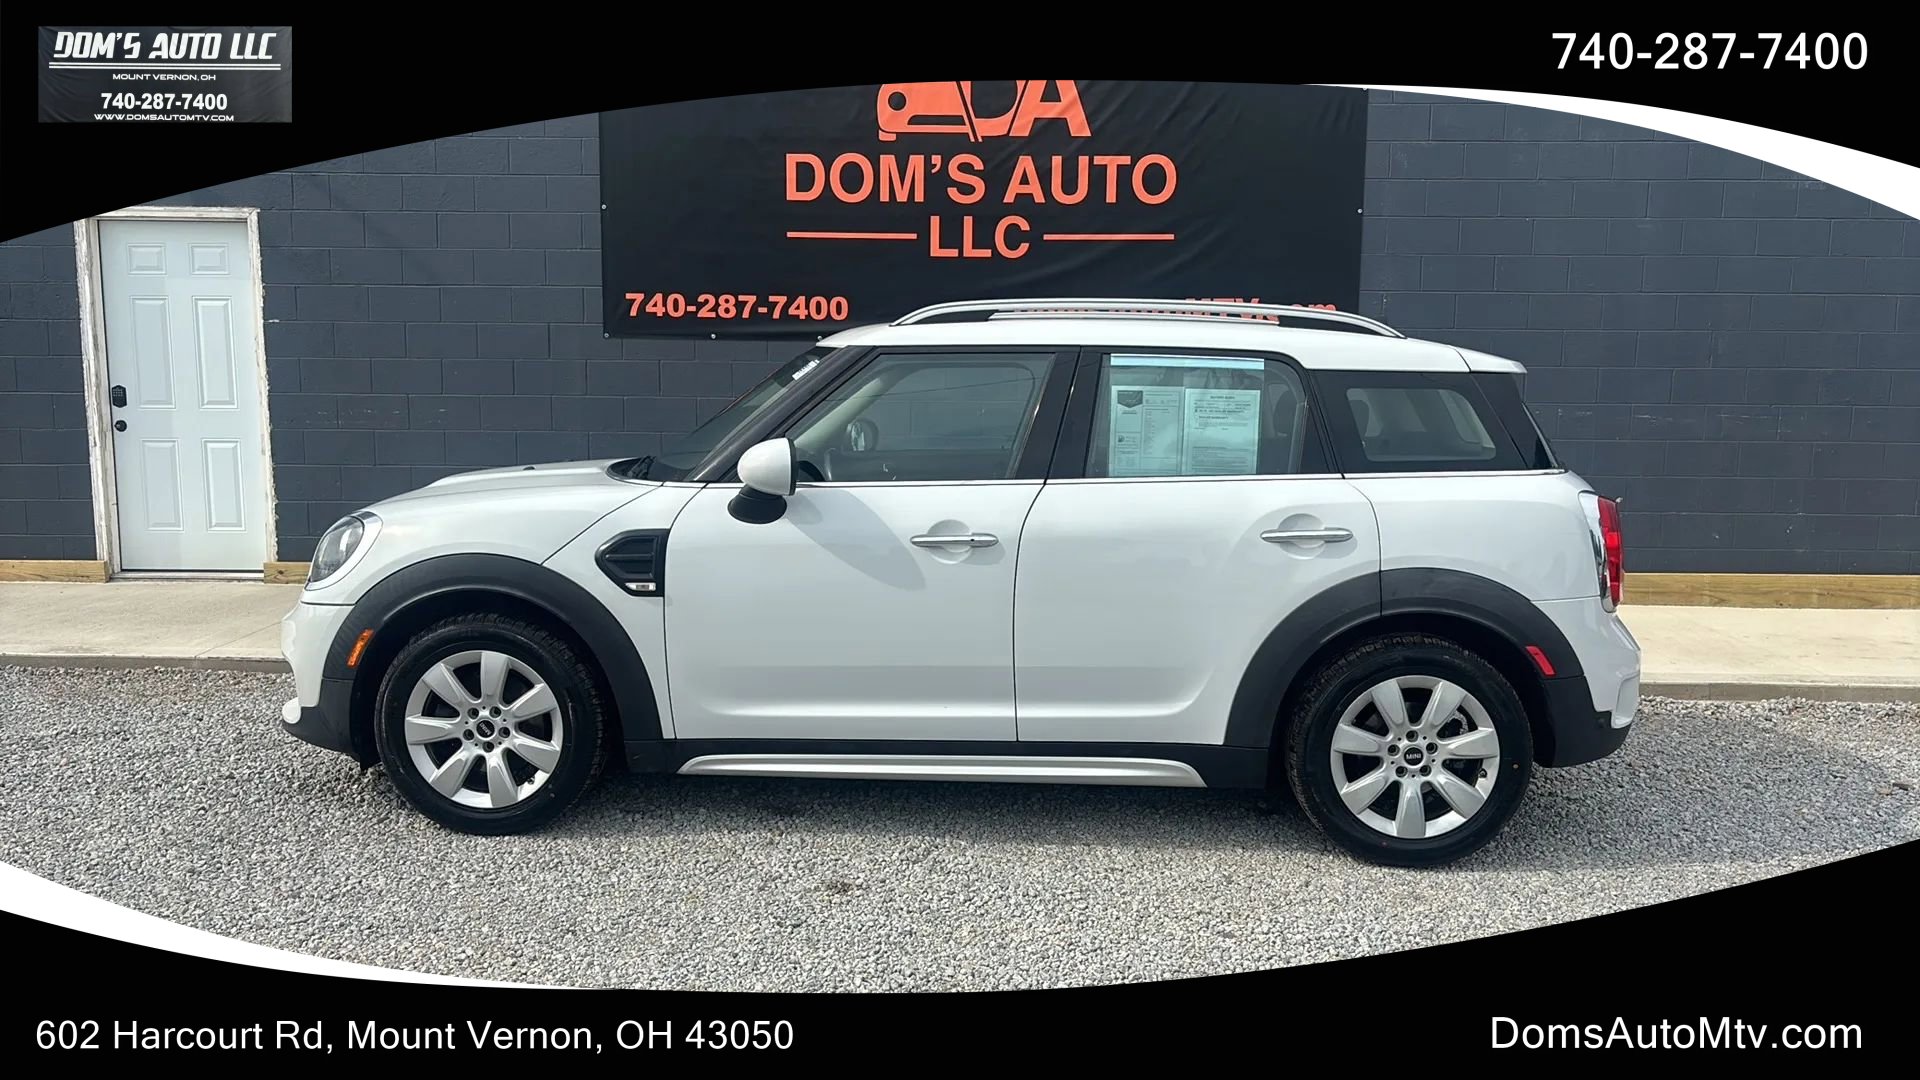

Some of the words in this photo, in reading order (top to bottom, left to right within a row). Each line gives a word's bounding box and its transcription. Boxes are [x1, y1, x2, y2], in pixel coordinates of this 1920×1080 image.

[785, 153, 986, 205] DOM'S
[1004, 154, 1178, 206] AUTO
[930, 215, 1030, 259] LLC
[625, 293, 849, 321] 740-287-7400
